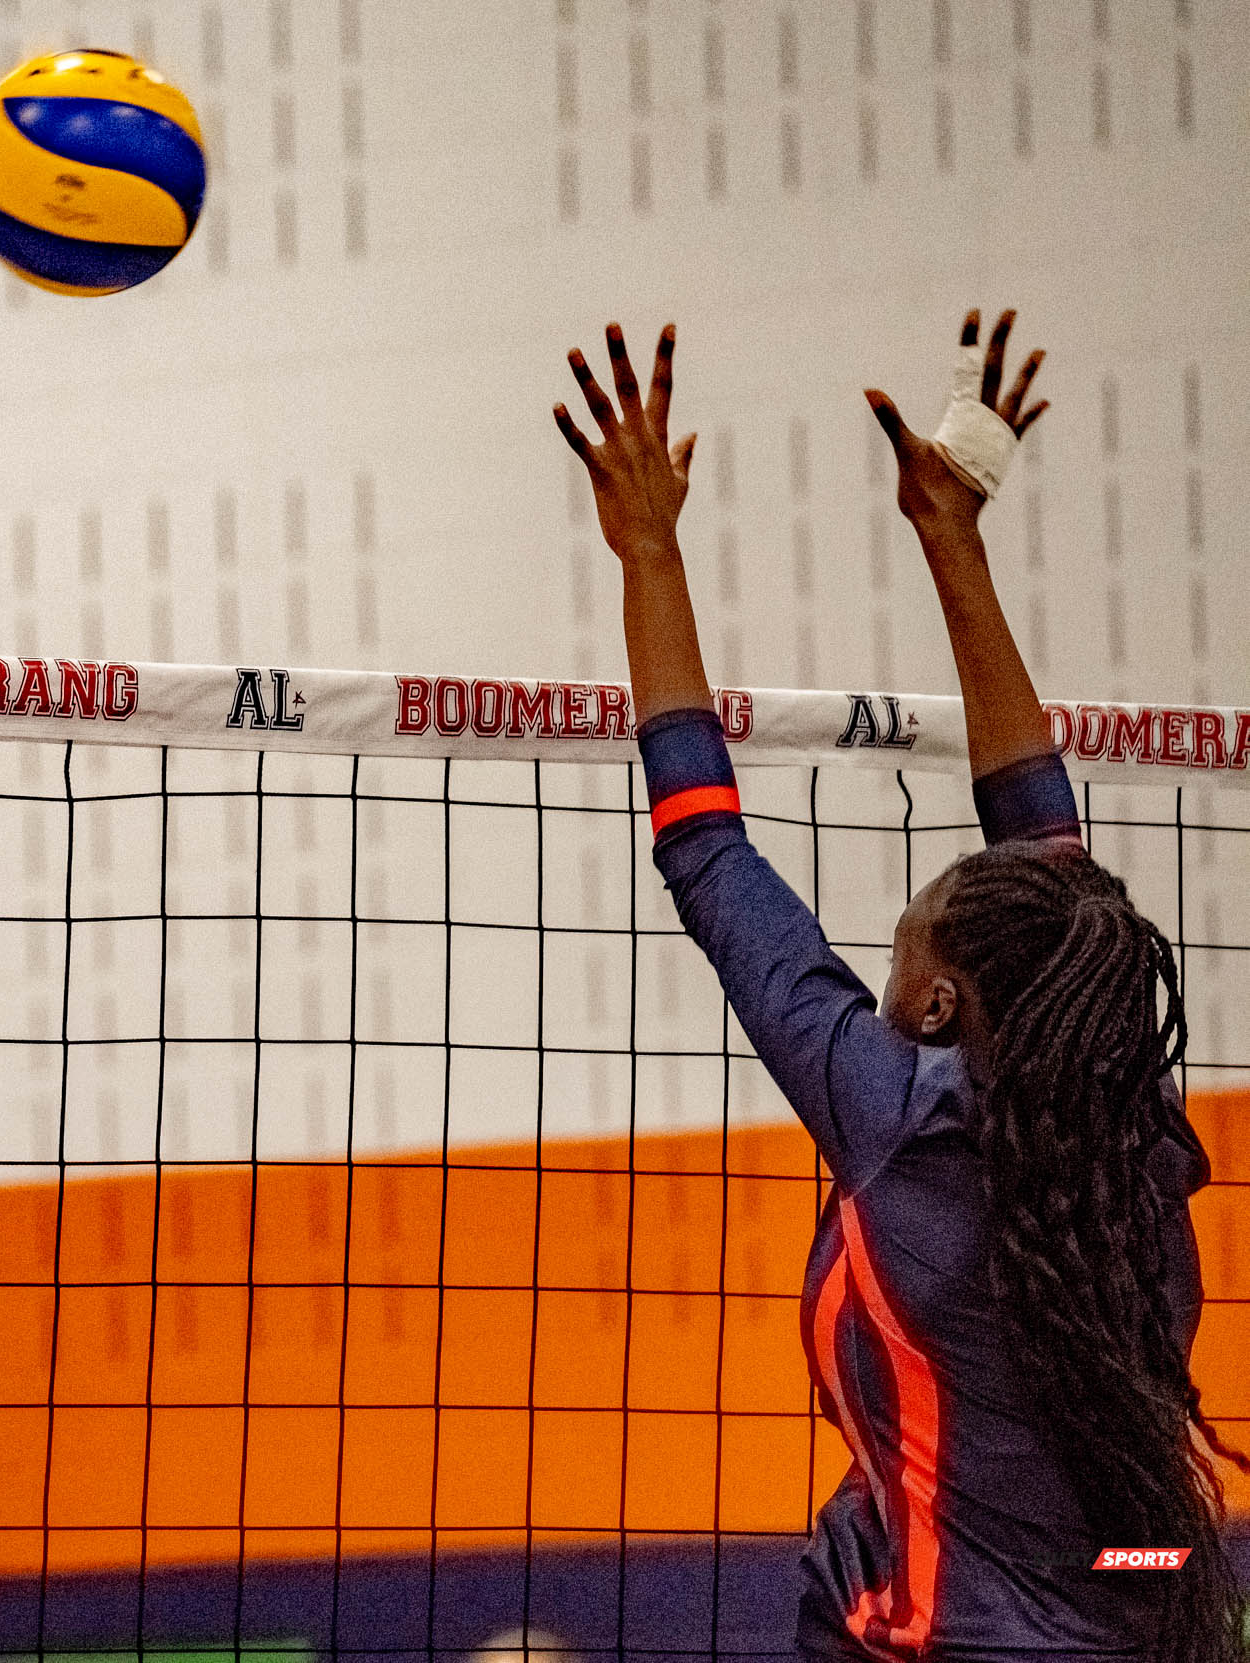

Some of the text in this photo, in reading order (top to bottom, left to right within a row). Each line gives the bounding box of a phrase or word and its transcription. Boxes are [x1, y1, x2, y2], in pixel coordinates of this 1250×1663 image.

[226, 668, 305, 731] AL
[395, 675, 753, 743] BOOMERG
[835, 694, 917, 749] AL
[1041, 703, 1250, 770] OOMERA
